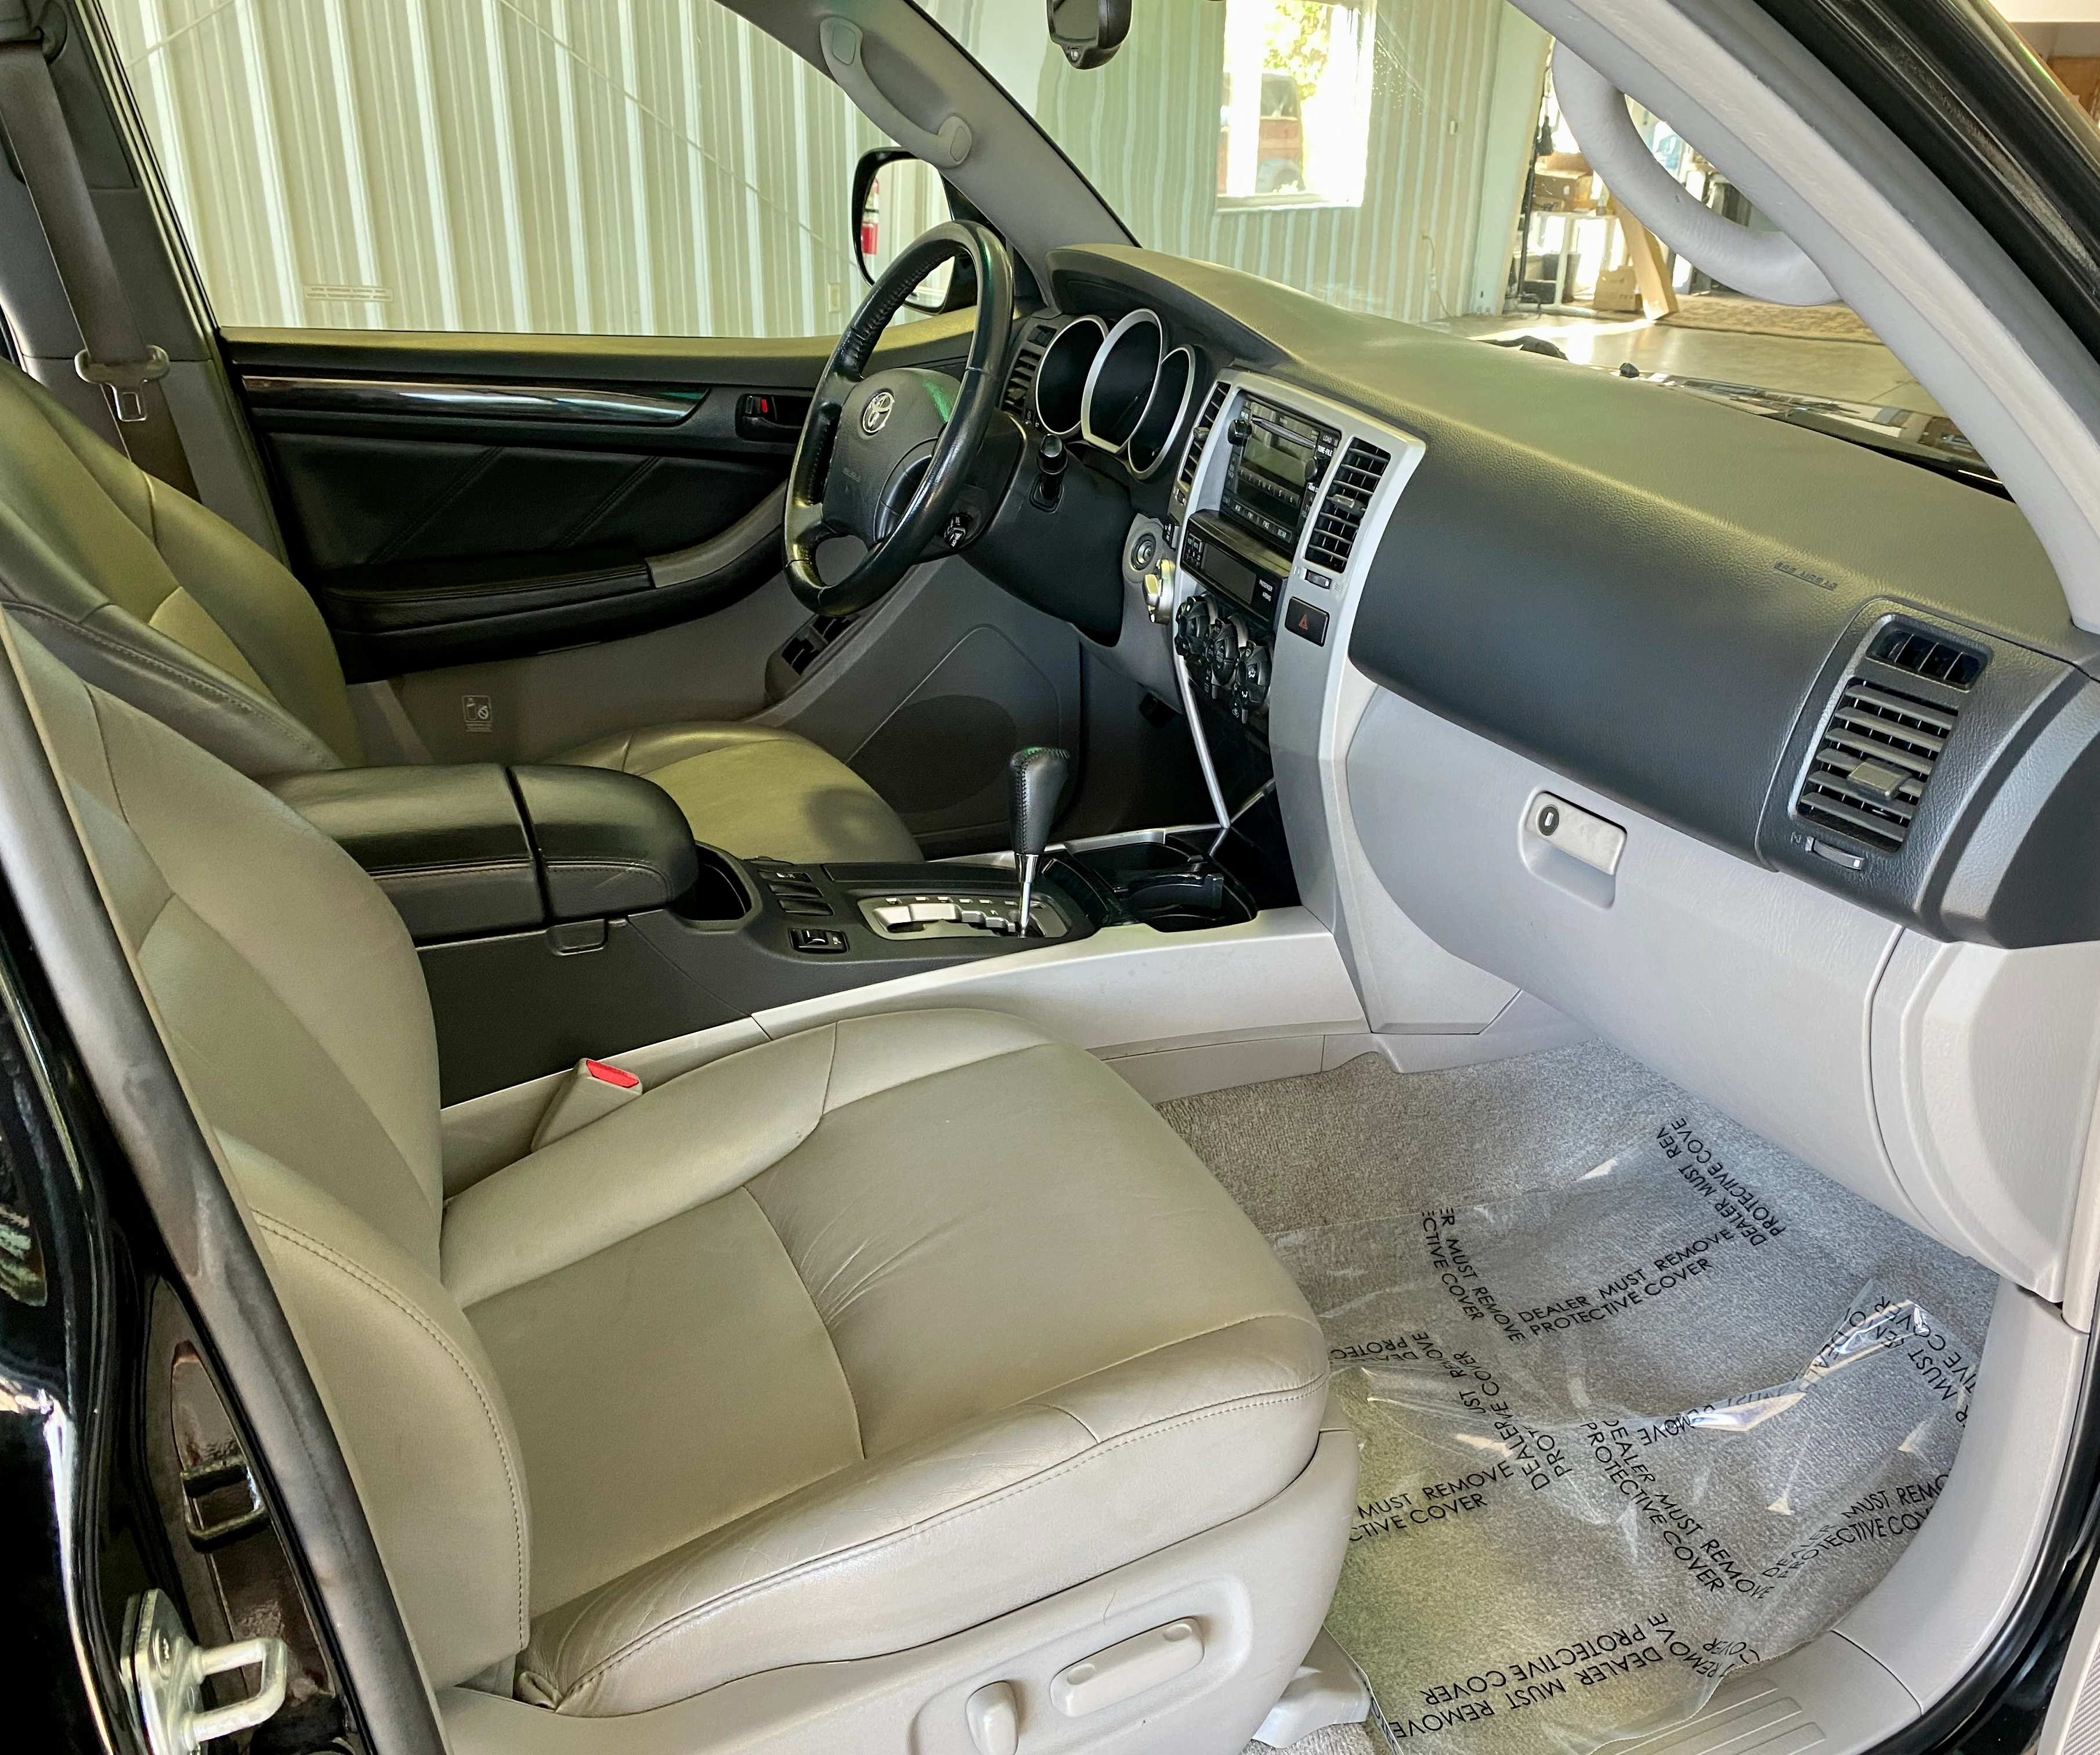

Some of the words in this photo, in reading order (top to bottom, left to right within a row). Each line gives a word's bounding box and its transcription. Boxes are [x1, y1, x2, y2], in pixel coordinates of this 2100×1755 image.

[1671, 1118, 1712, 1164] COVE
[1678, 1164, 1717, 1198] MUST
[1707, 1162, 1786, 1236] PROTECTIVE
[1714, 1197, 1768, 1246] DEALER
[1441, 1273, 1485, 1321] COVER
[1445, 1238, 1479, 1278] MUST
[1472, 1286, 1526, 1342] REMOVE
[1517, 1296, 1591, 1323] DEALER
[1598, 1269, 1647, 1299] MUST
[1654, 1229, 1734, 1272] REMOVE
[1530, 1291, 1643, 1336] PROTECTIVE
[1644, 1258, 1712, 1296] COVER
[1453, 1350, 1500, 1396] COVER
[1907, 1349, 1958, 1401] MUST
[1494, 1421, 1550, 1491] DEALER
[1357, 1493, 1412, 1519] MUST
[1422, 1460, 1515, 1501] REMOVE
[1409, 1493, 1488, 1524] COVER
[1579, 1421, 1668, 1525] PROTECTIVE
[1663, 1530, 1725, 1593] COVER
[1654, 1494, 1704, 1536] MUST
[1700, 1539, 1775, 1599] REMOVE
[1762, 1524, 1834, 1578] DEALER
[1841, 1490, 1891, 1519] MUST
[1777, 1518, 1888, 1579] PROTECTIVE
[1508, 1623, 1647, 1682] PROTECTIVE
[1574, 1646, 1664, 1686] DEALER
[1647, 1613, 1723, 1678] REMOVE
[1419, 1670, 1507, 1705] COVER
[1505, 1677, 1567, 1710] MUST
[1389, 1699, 1495, 1739] REMOVE
